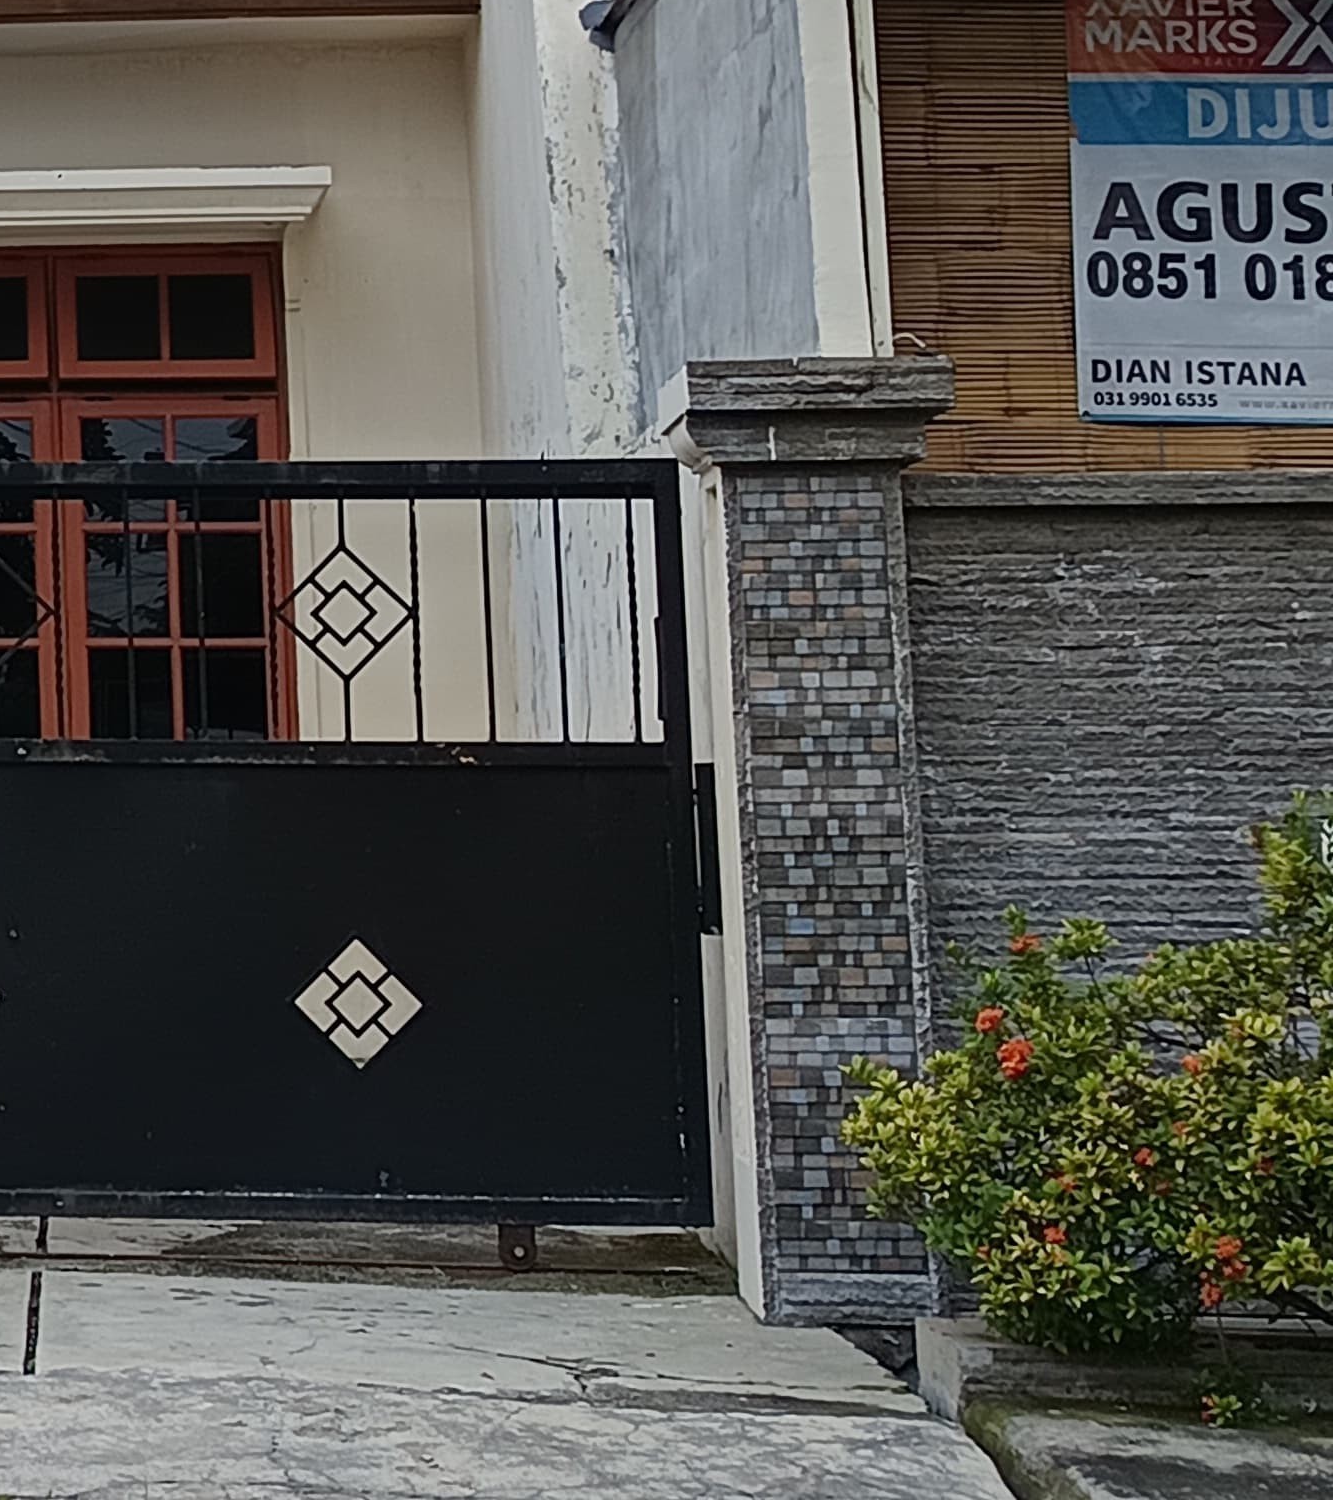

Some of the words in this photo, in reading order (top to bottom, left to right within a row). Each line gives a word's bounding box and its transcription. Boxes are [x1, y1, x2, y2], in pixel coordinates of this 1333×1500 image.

[1085, 19, 1258, 54] MARKS
[1092, 181, 1333, 244] AGUS
[1087, 251, 1217, 299] 0851
[1091, 359, 1171, 384] DIAN
[1186, 360, 1307, 386] ISTANA
[1094, 392, 1124, 406] 031
[1129, 392, 1171, 407] 9901
[1176, 393, 1218, 408] 6535
